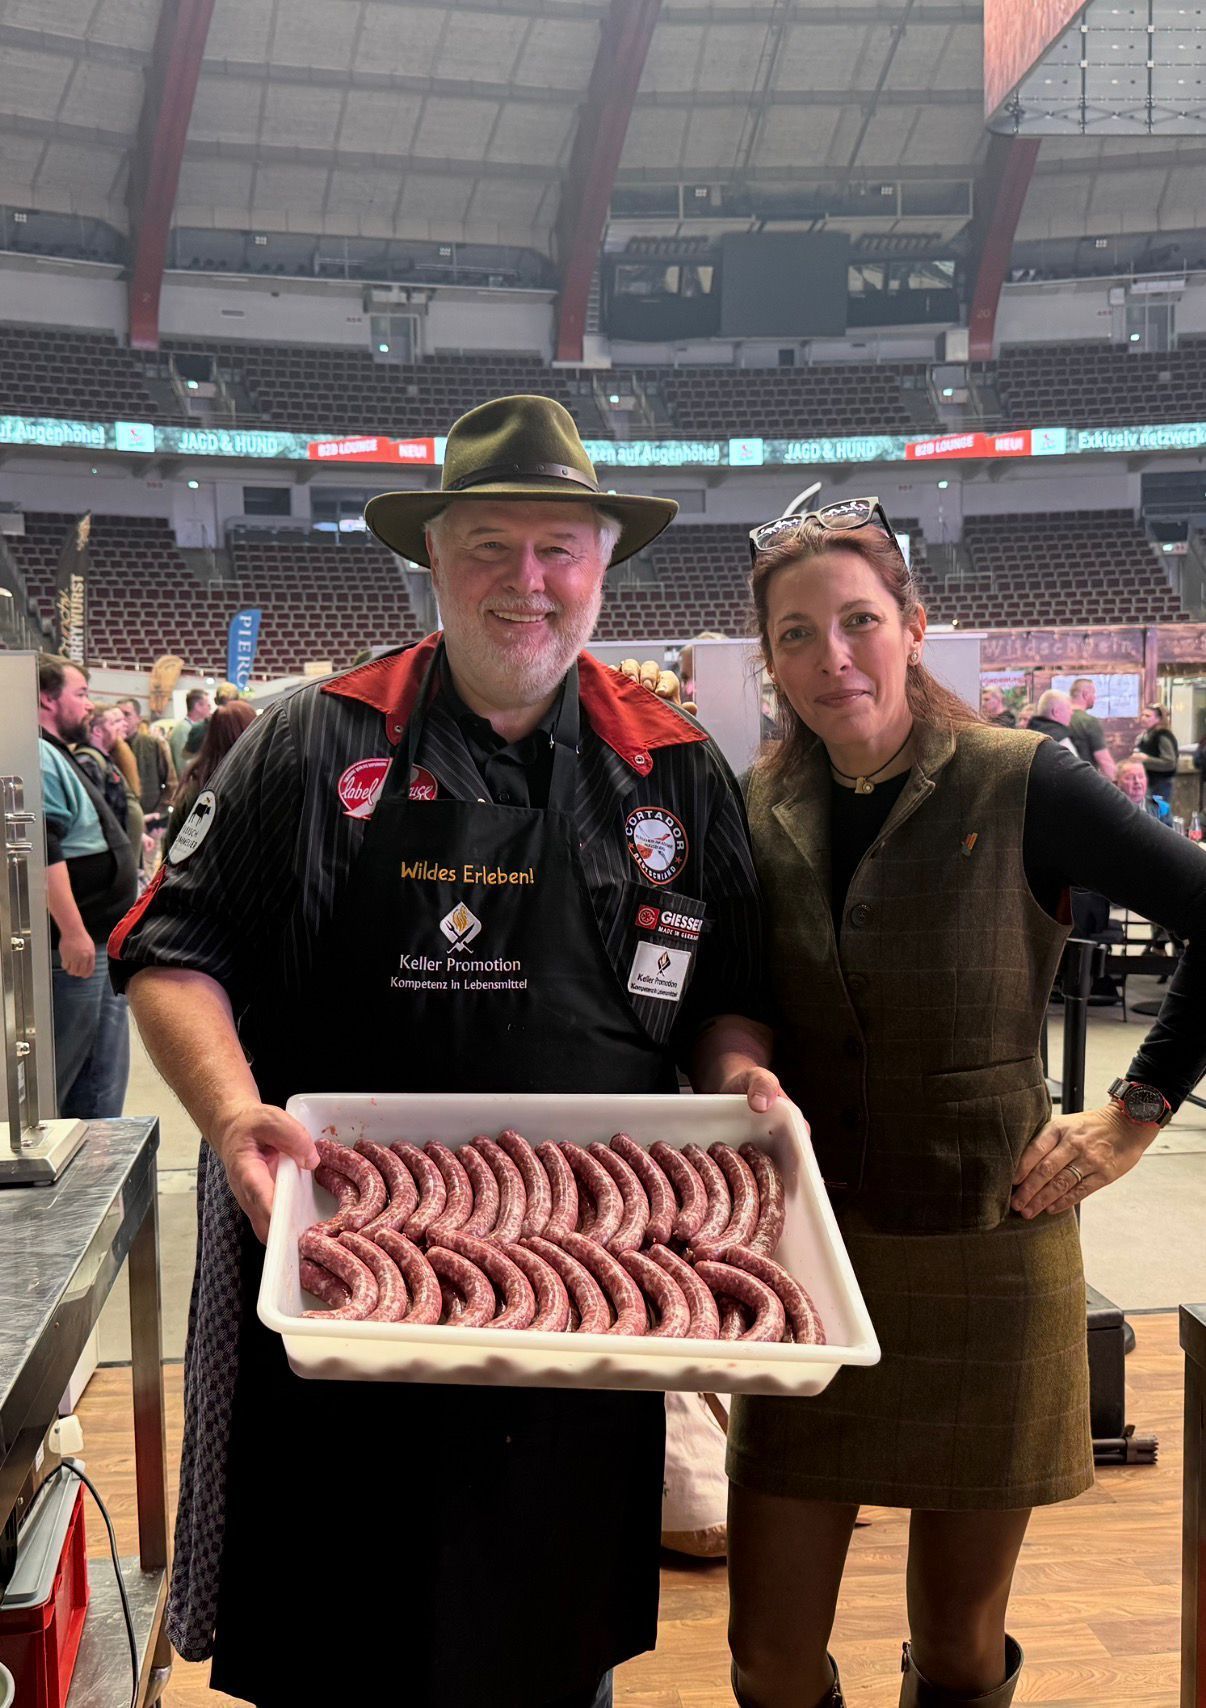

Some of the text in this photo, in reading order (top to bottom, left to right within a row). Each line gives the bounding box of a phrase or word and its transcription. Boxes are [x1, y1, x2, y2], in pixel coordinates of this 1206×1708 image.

[0, 420, 106, 444] uf Augenhöhe!
[178, 431, 278, 453] JAGD & HUND
[1078, 429, 1138, 449] Exklusiv
[618, 444, 640, 461] auf
[641, 444, 720, 463] Augenhöhe!
[784, 439, 876, 459] JAGD & HUND
[935, 435, 974, 453] LOUNGE
[69, 573, 85, 666] URRYWURST
[342, 776, 433, 806] label uge
[625, 810, 685, 850] CORTADOR
[401, 860, 535, 885] Wildes Erleben!
[633, 853, 676, 881] DEUTSCHLAND
[658, 925, 673, 936] MADE
[400, 954, 521, 972] Keller Promotion
[390, 976, 447, 991] Kompetenz
[464, 978, 527, 990] Lebensmittel
[637, 972, 654, 984] Keller
